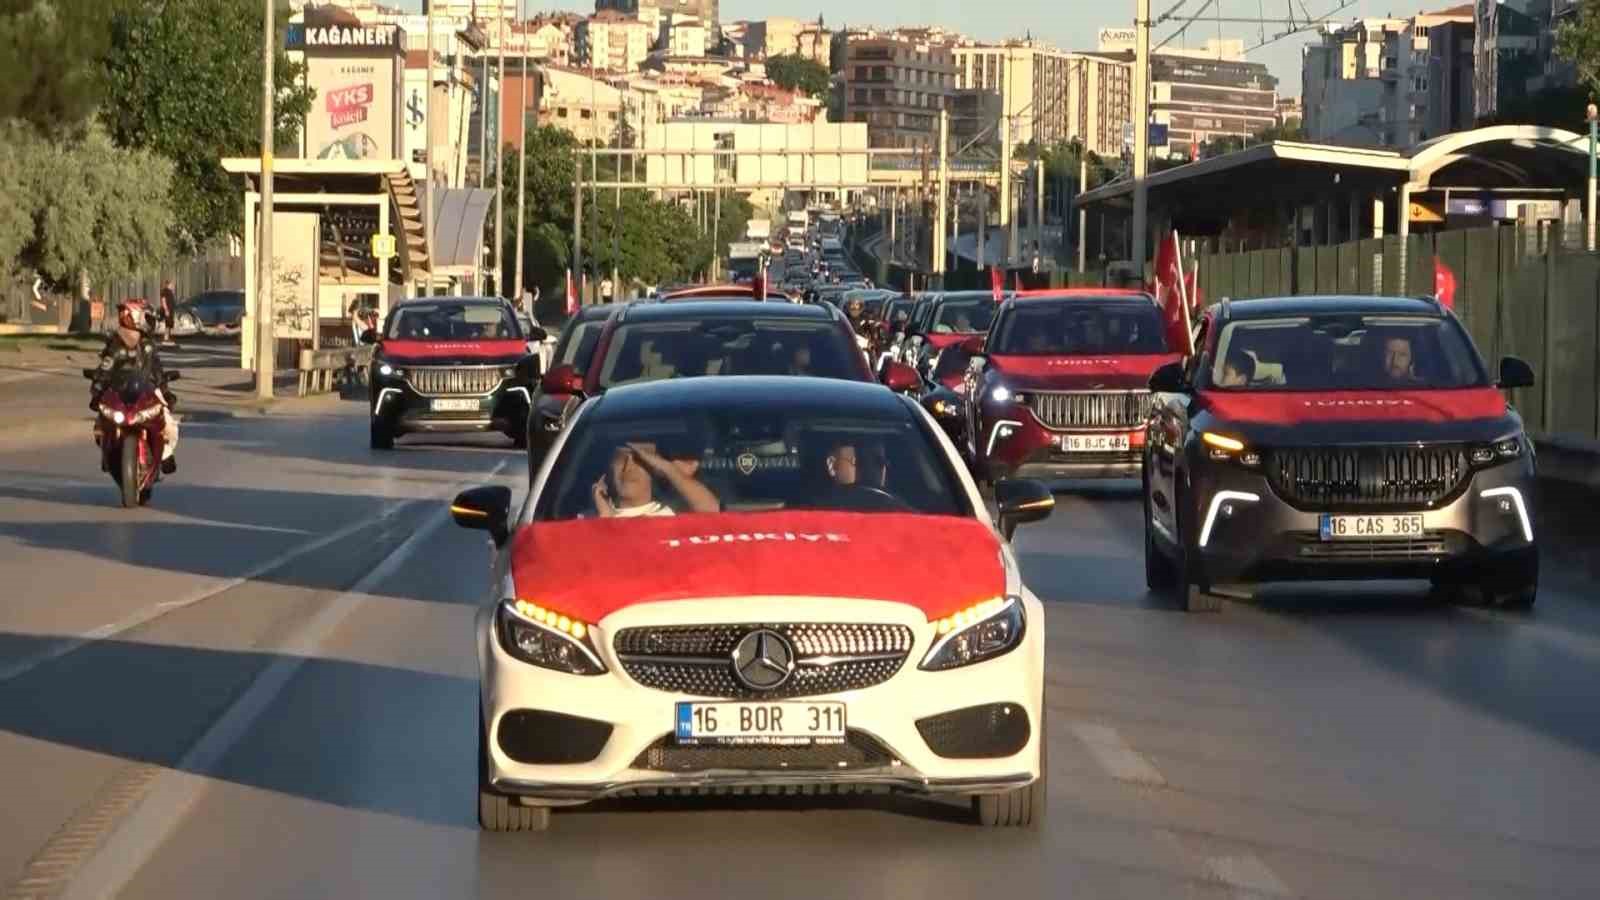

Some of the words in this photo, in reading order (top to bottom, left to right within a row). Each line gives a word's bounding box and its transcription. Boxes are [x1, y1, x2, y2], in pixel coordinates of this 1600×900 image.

[331, 86, 368, 107] YKS
[1331, 517, 1346, 534] 16
[1356, 517, 1384, 534] CAS
[1392, 517, 1420, 533] 365
[694, 707, 717, 732] 16
[740, 706, 783, 732] BOR
[808, 707, 843, 731] 311
